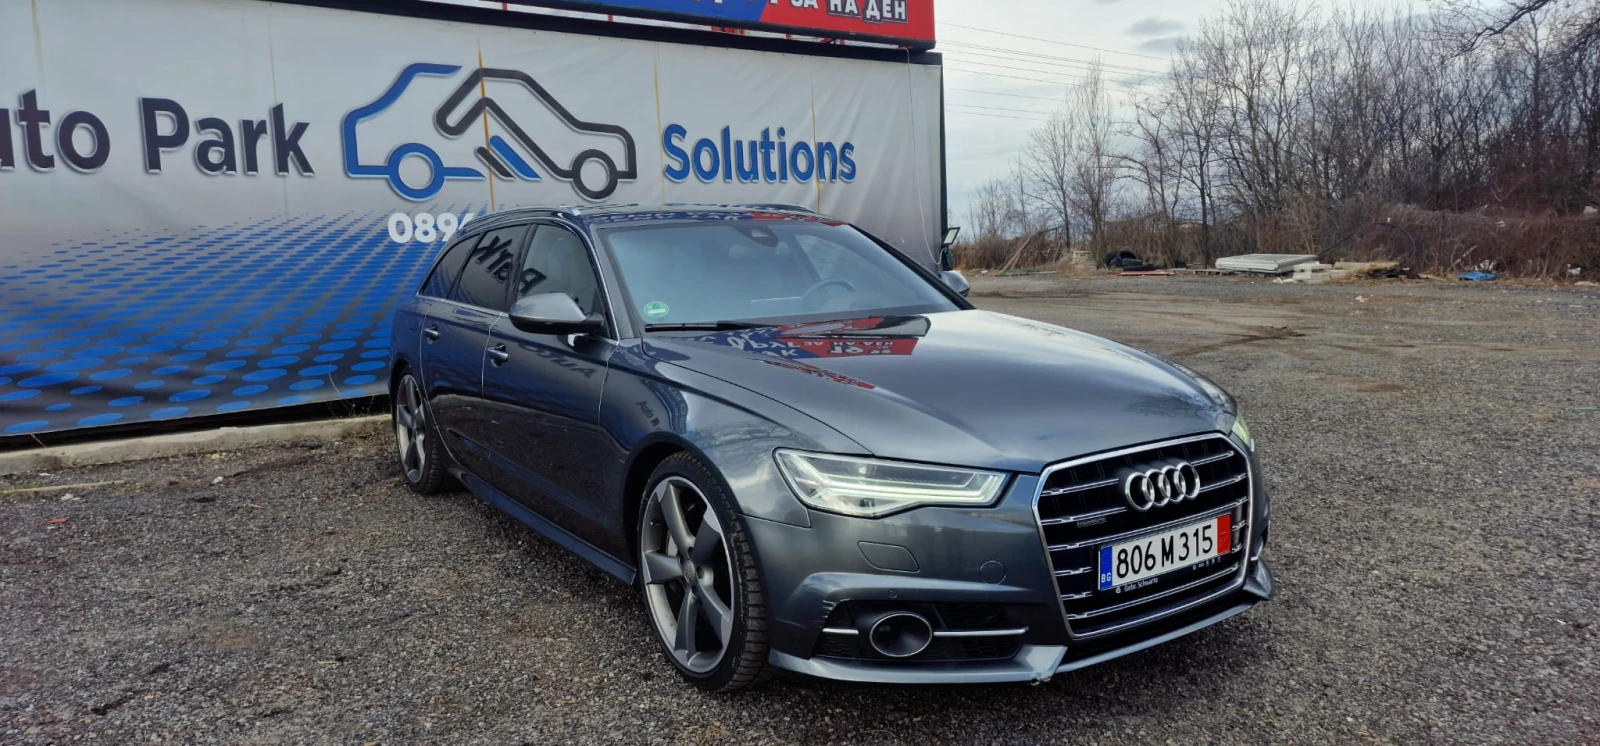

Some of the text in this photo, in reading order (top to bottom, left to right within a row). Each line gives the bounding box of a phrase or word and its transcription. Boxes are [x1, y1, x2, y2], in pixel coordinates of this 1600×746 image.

[830, 0, 858, 14] НА
[866, 0, 906, 20] ДЕН
[138, 96, 316, 176] Park
[662, 123, 857, 184] Solutions
[1116, 540, 1157, 579] 806
[1101, 572, 1112, 583] BG
